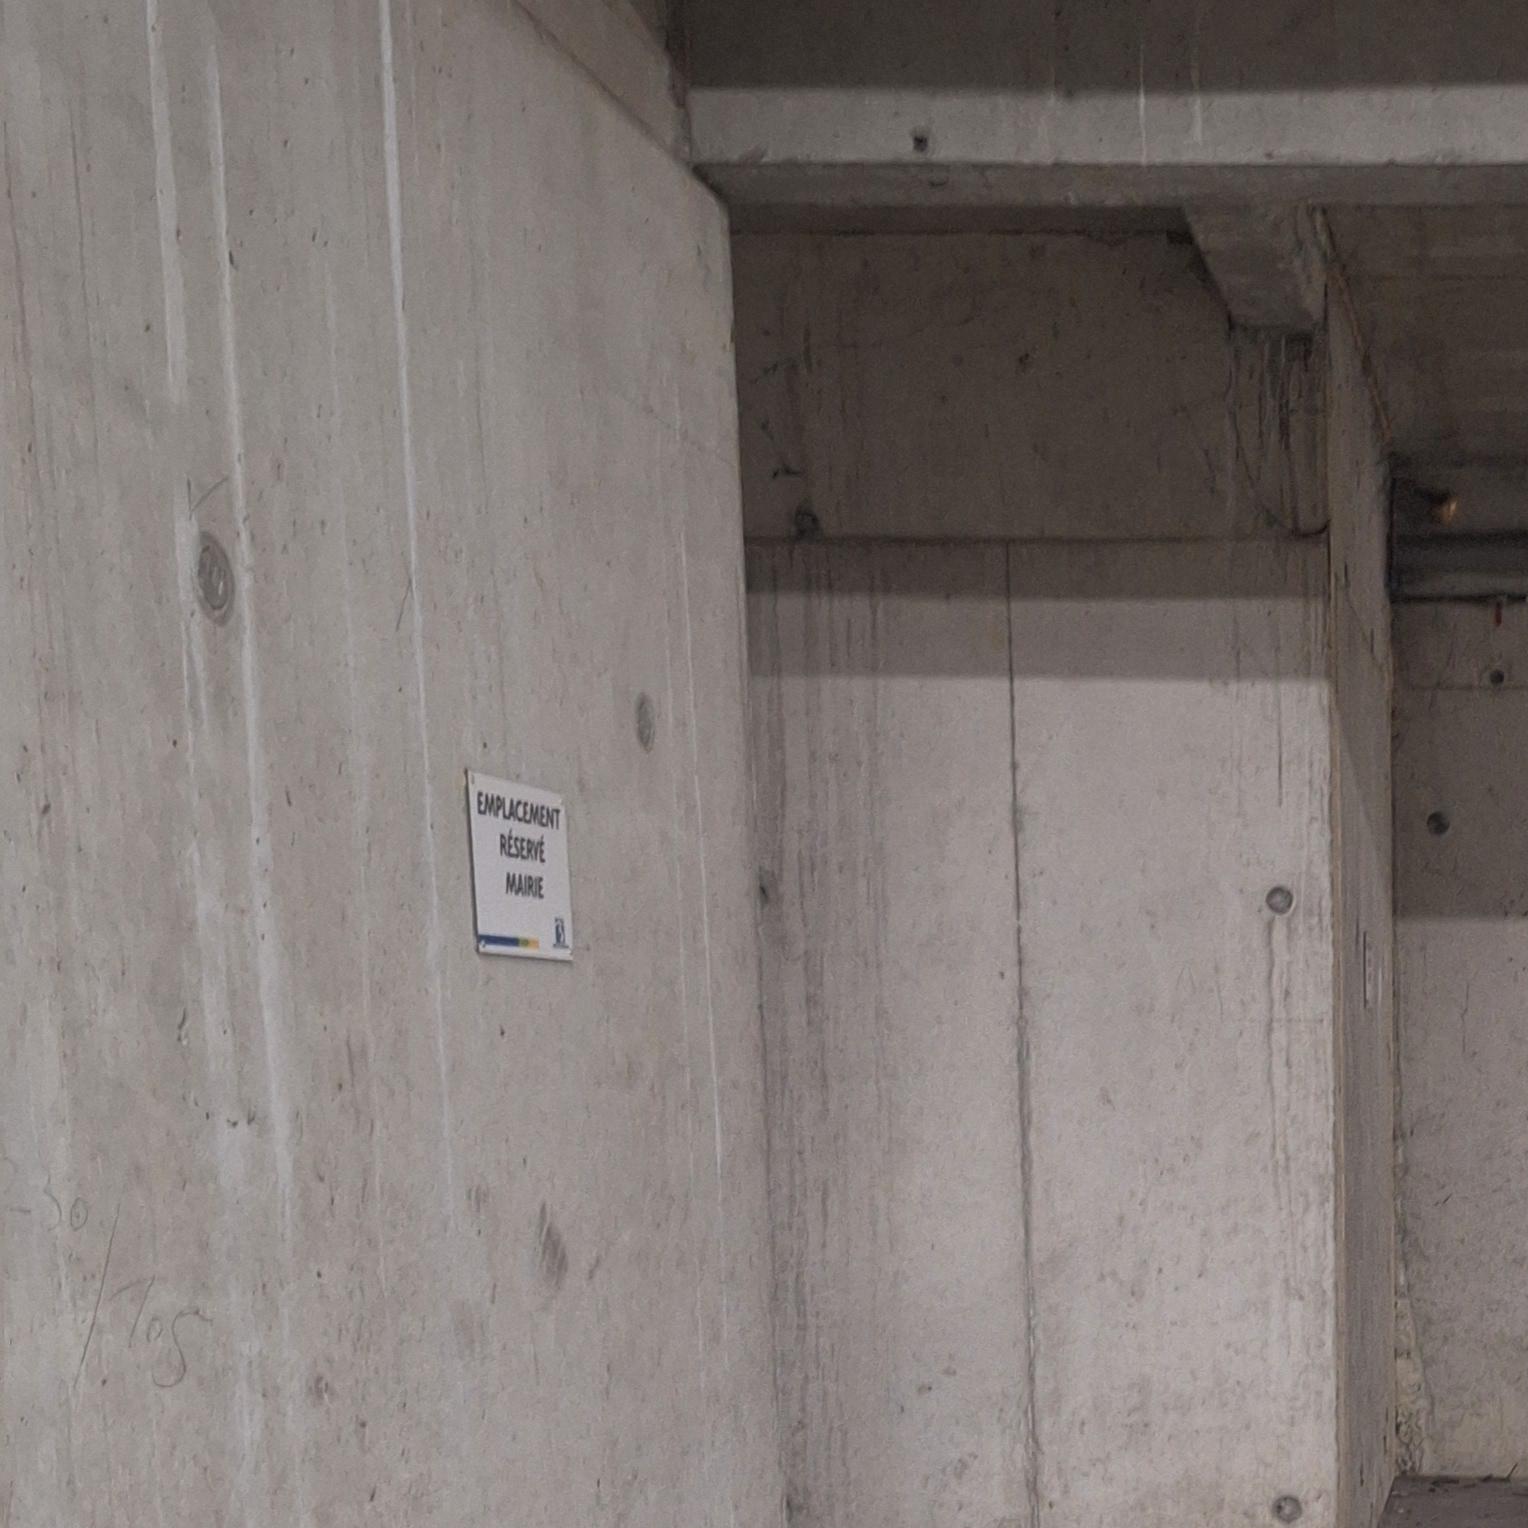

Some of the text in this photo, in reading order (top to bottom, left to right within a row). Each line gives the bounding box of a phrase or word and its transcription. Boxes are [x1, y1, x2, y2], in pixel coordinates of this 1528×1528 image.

[477, 791, 561, 830] EMPLACEMENT
[499, 828, 546, 863] RÉSERVÉ
[505, 872, 544, 899] MAIRIE
